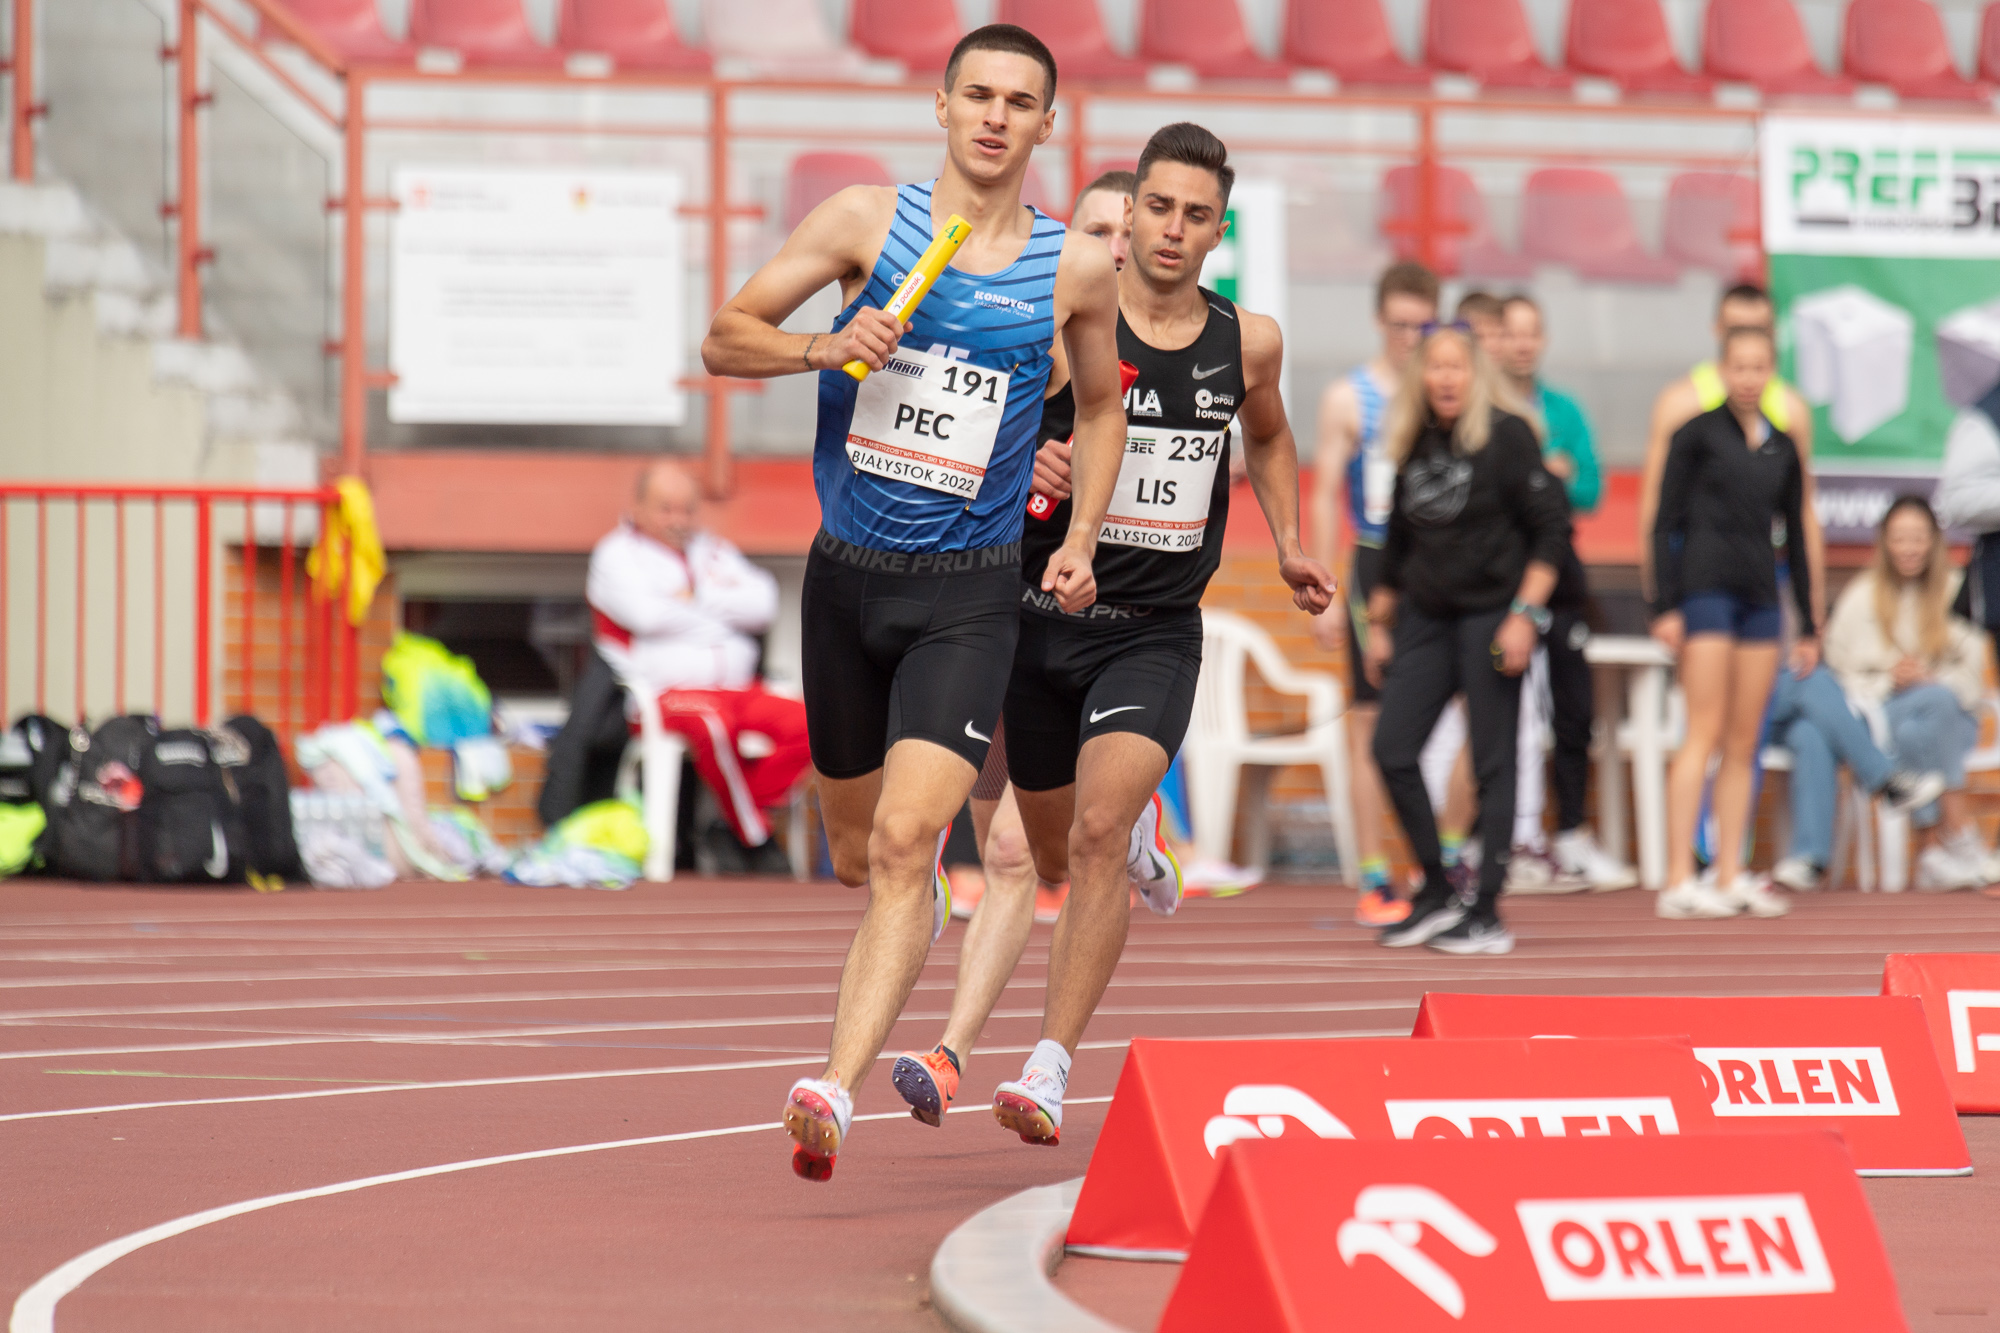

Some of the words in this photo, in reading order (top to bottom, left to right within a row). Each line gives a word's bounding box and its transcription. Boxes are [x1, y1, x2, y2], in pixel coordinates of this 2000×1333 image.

[942, 366, 998, 404] 191
[1213, 396, 1234, 406] OPOLE
[894, 403, 955, 440] PEC
[851, 436, 867, 446] PZLA
[868, 441, 913, 458] MISTRZOSTWA
[914, 453, 938, 463] POLSKI
[946, 460, 984, 475] SZTAFETACH
[1126, 437, 1156, 454] BET
[1168, 436, 1219, 462] 234
[852, 450, 934, 482] BIAŁYSTOK
[939, 472, 975, 493] 2022
[1136, 478, 1177, 506] LIS
[1100, 527, 1171, 546] AŁYSTOK
[1150, 521, 1173, 529] POLSKI
[839, 549, 909, 573] NIKE
[910, 551, 974, 574] PRO
[980, 540, 1021, 568] NIK
[1551, 1217, 1805, 1280] ORLEN
